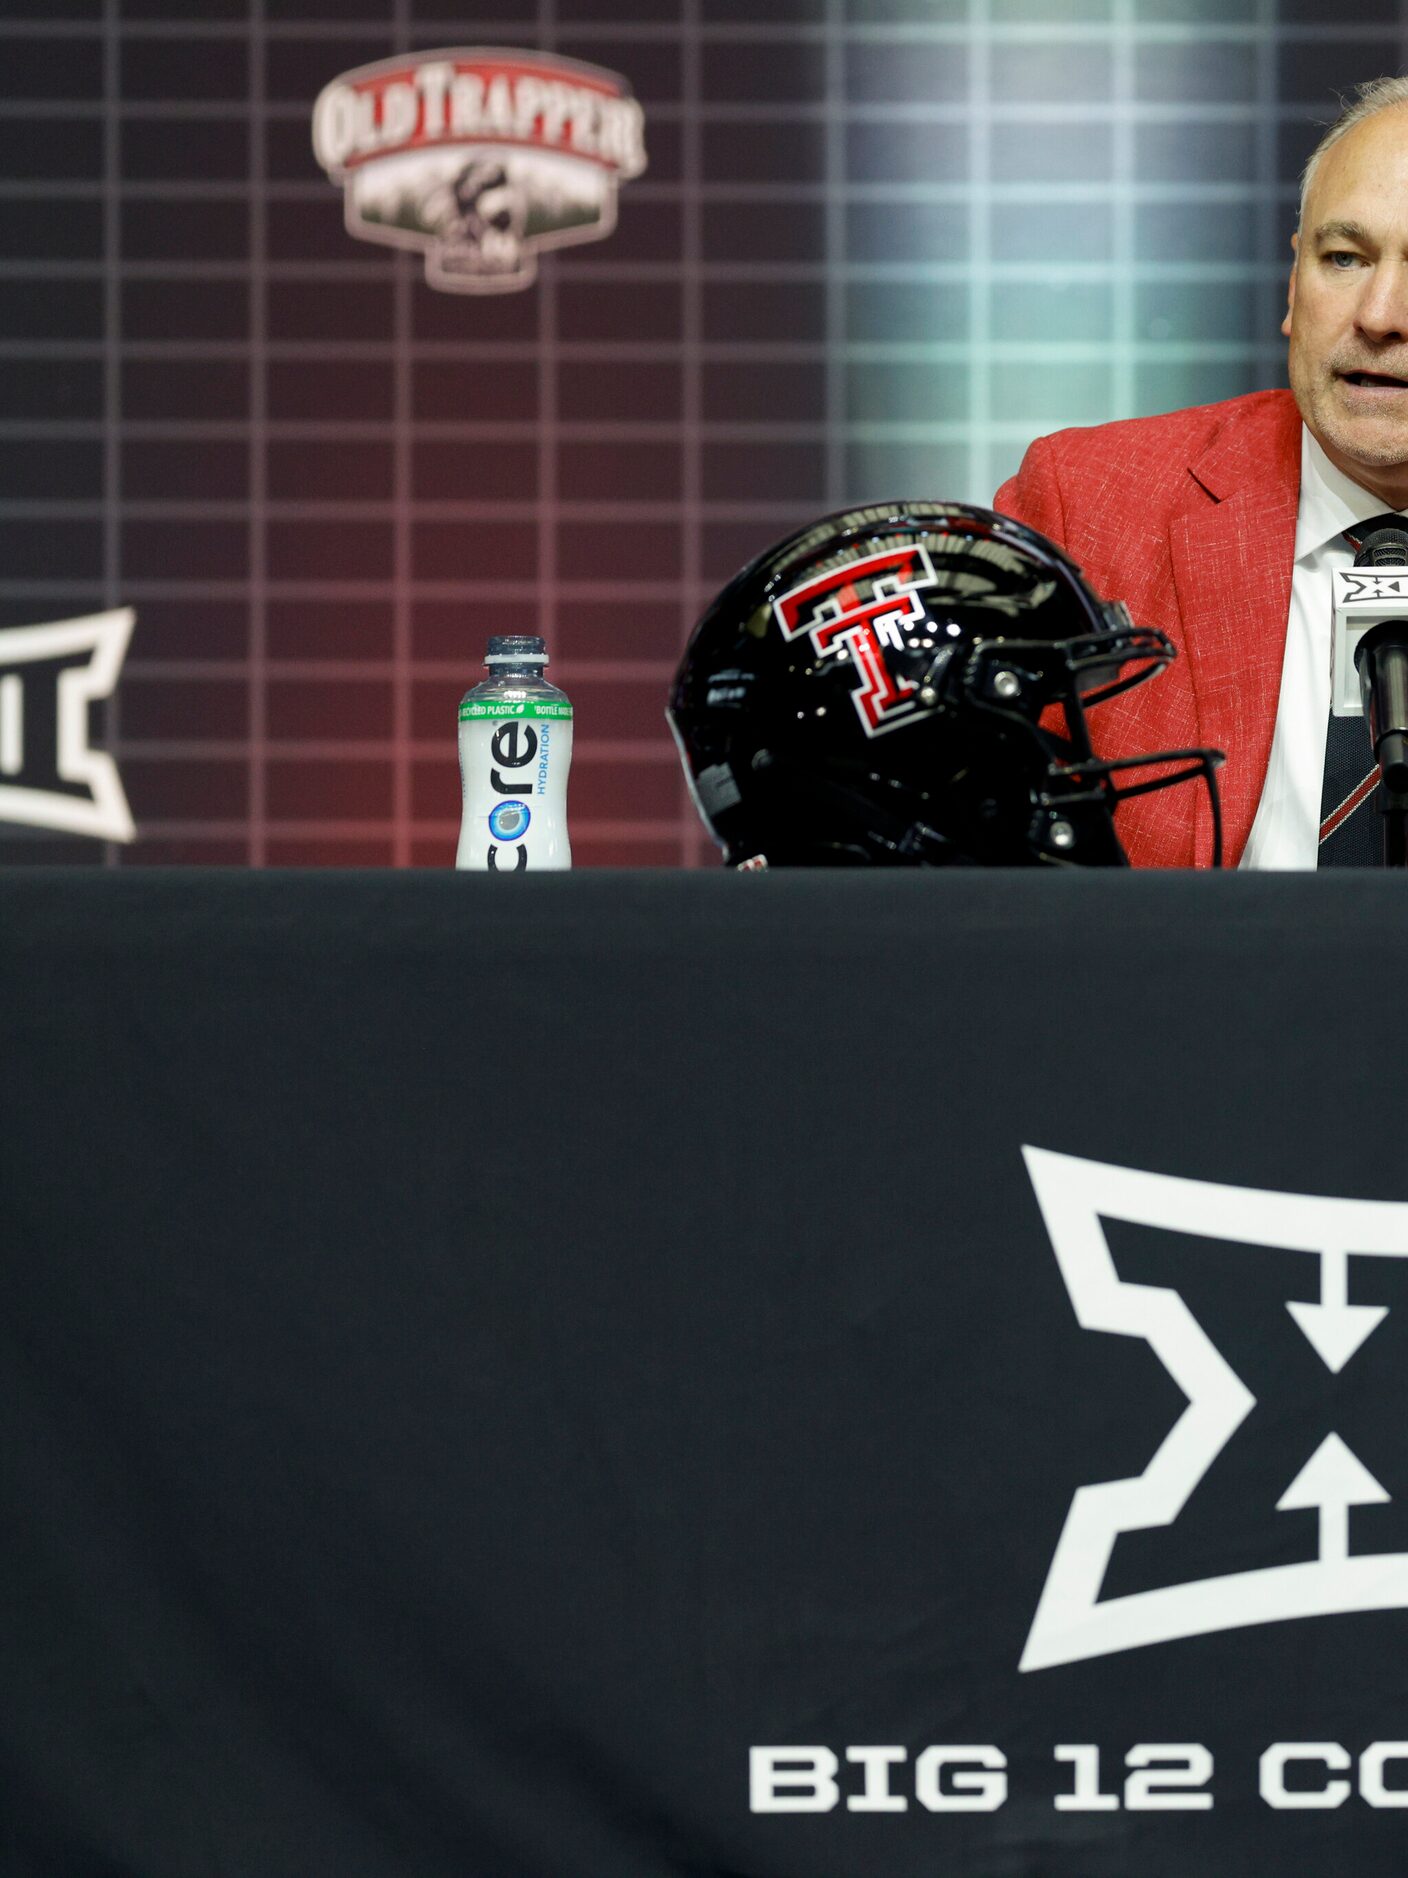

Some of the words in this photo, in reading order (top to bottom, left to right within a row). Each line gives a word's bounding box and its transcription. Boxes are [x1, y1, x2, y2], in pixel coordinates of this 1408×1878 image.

[312, 84, 420, 171] OLD
[413, 61, 647, 179] TRAPPER
[488, 705, 515, 715] PLASTIC
[537, 723, 550, 795] HYDRATION
[748, 1744, 1008, 1814] BIG
[1053, 1743, 1214, 1812] 12
